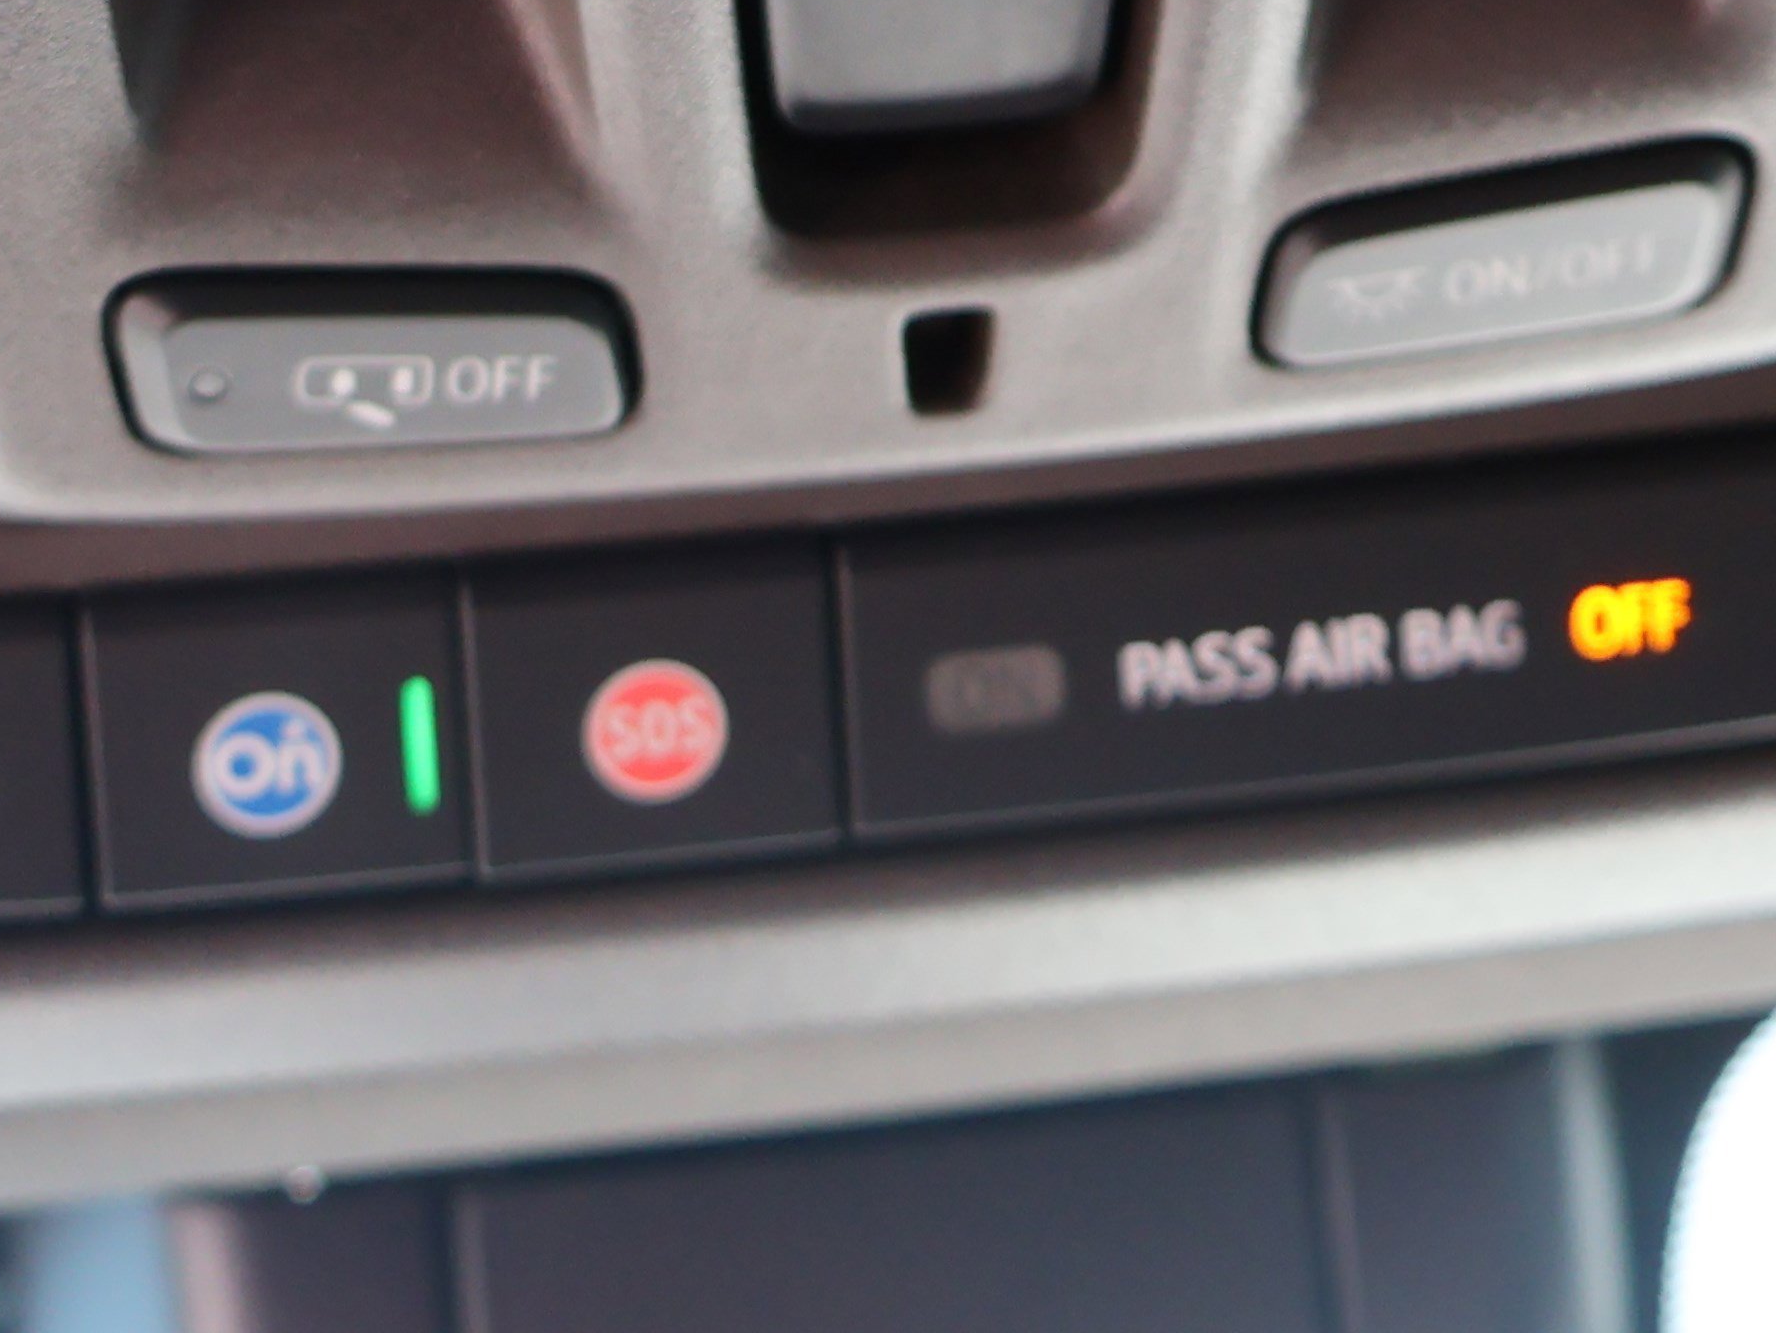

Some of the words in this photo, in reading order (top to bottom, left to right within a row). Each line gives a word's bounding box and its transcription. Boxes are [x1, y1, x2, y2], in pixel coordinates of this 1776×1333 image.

[446, 354, 557, 404] OFF
[1117, 626, 1278, 712] PASS
[1284, 614, 1396, 693] AIR
[1401, 598, 1527, 681] BAG
[1567, 576, 1693, 661] OFF
[604, 695, 717, 764] SOS
